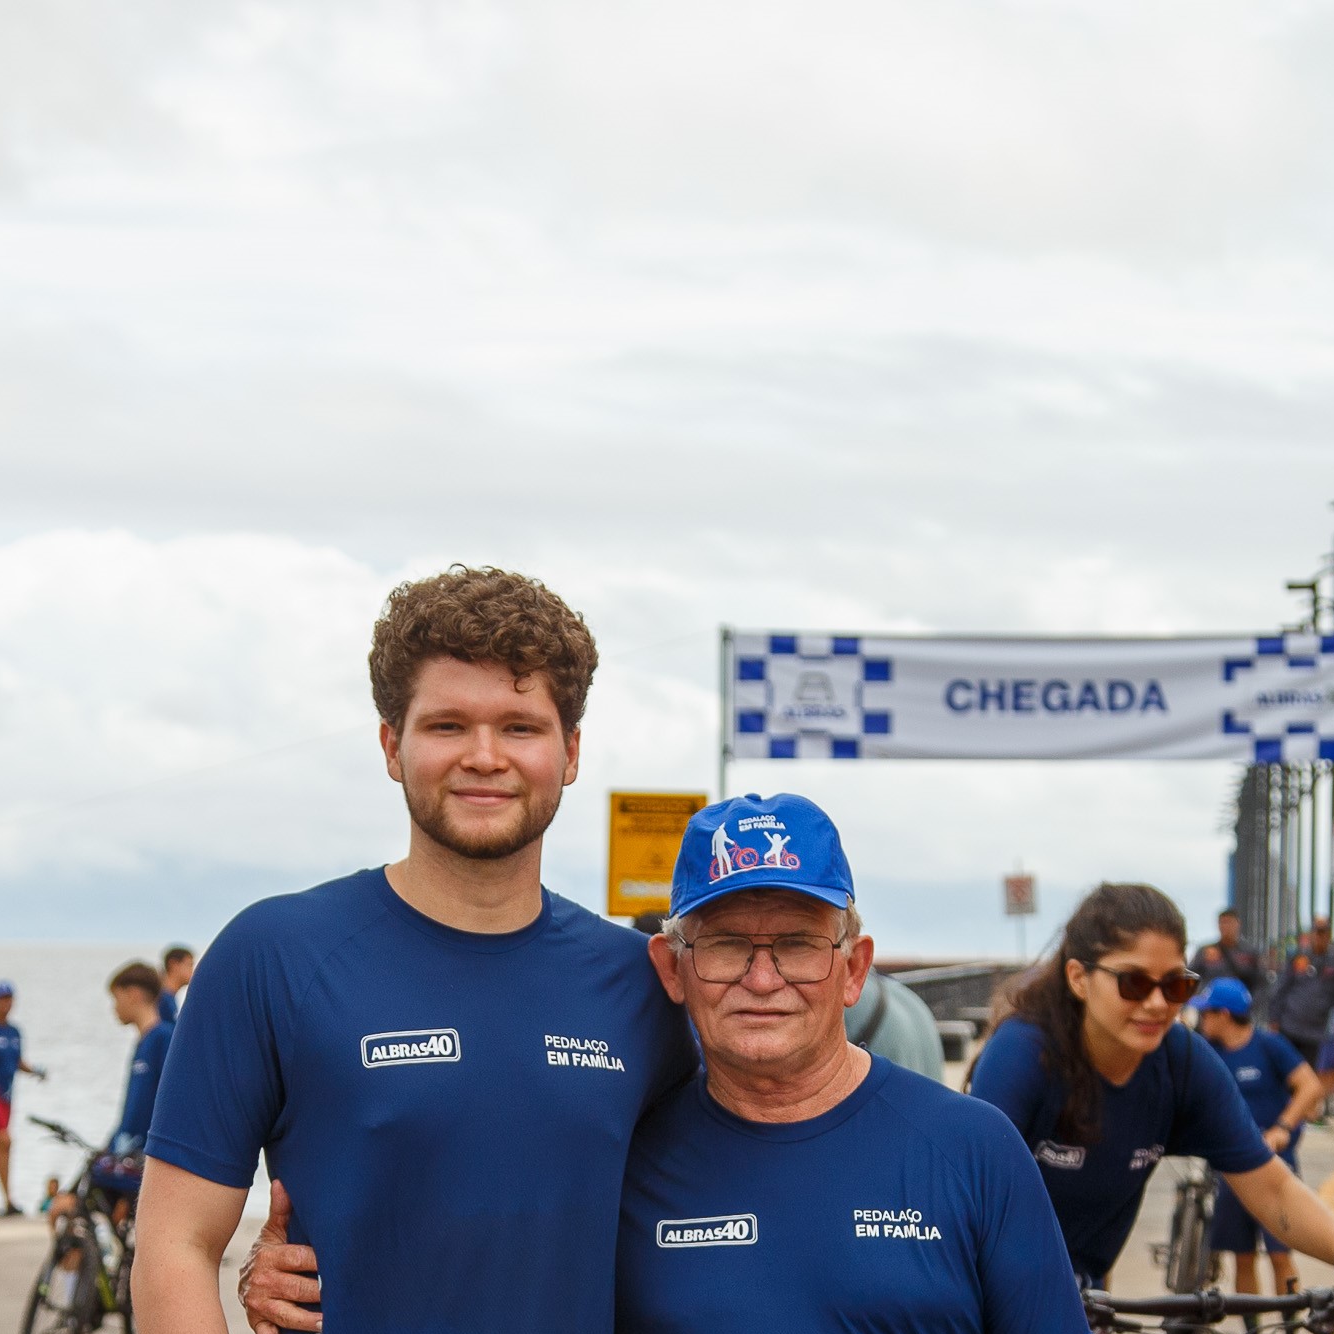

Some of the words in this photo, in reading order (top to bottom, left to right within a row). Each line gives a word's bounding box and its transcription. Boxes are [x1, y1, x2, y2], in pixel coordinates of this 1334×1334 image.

[944, 679, 1168, 713] CHEGADA
[739, 823, 753, 832] EM
[371, 1035, 453, 1061] ALBRAS40
[544, 1034, 609, 1054] PEDALAÇO
[546, 1050, 570, 1066] EM
[572, 1052, 625, 1072] FAMÍLIA
[853, 1209, 922, 1224] PEDALAÇO
[664, 1220, 749, 1242] ALBRAS40
[855, 1224, 880, 1238] EM
